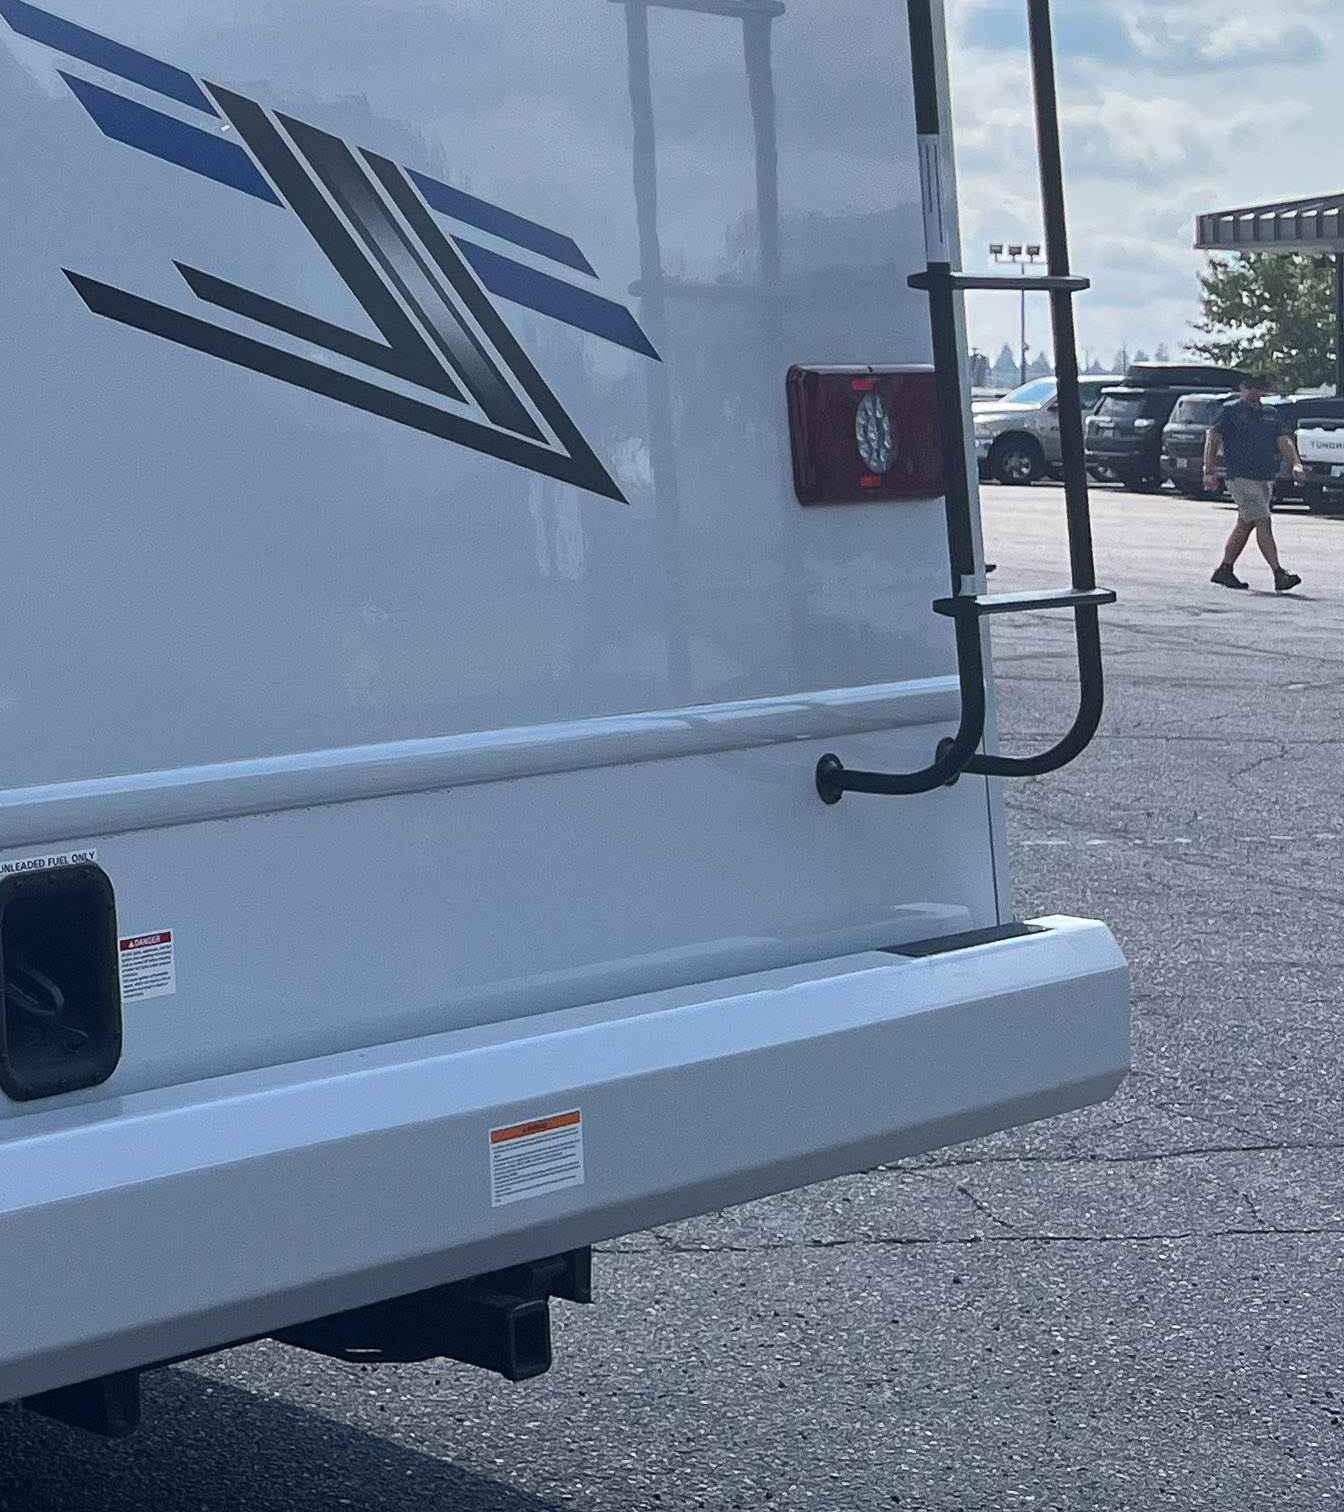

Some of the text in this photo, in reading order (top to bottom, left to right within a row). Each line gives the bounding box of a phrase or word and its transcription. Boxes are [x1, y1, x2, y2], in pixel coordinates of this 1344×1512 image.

[48, 855, 69, 867] FUEL
[72, 850, 96, 864] ONLY
[134, 935, 161, 947] DANGER
